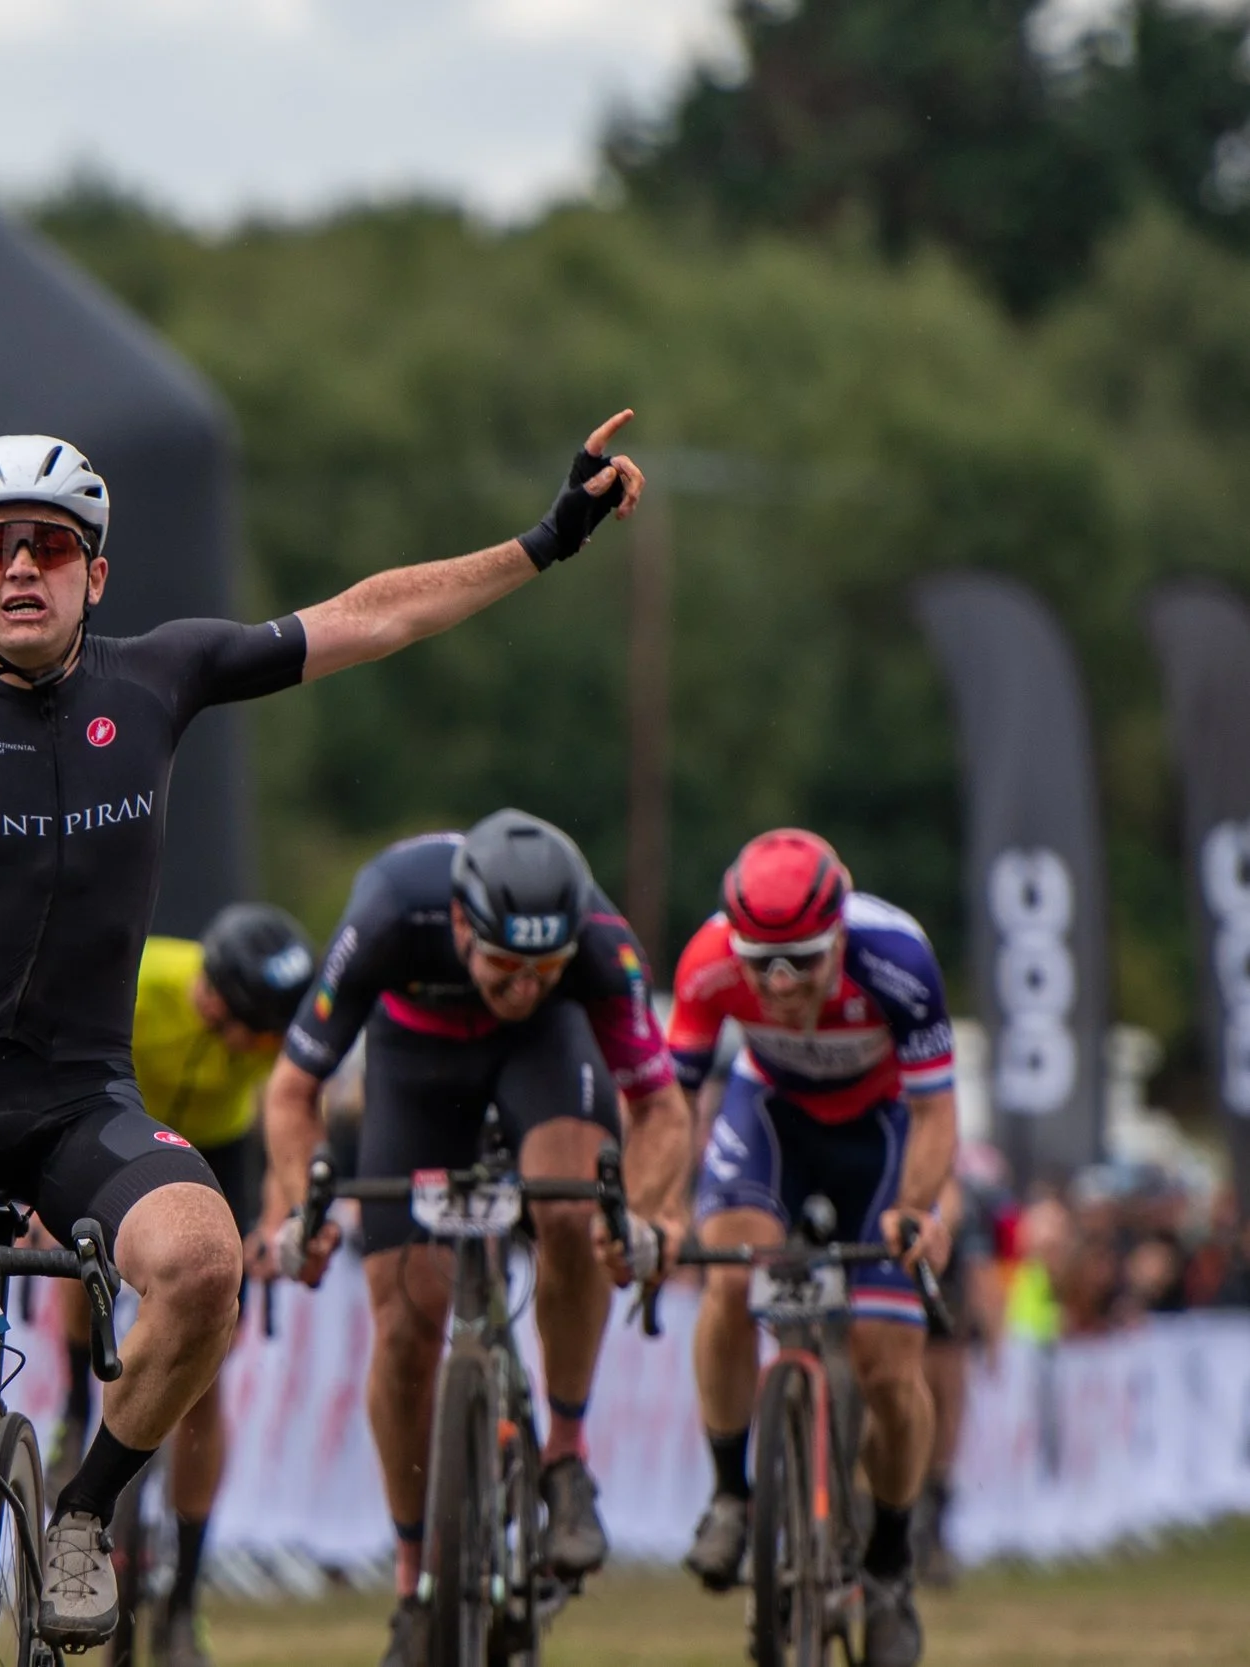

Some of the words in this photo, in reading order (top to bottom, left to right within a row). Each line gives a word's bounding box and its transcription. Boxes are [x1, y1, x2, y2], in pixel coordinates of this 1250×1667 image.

[64, 790, 154, 835] PIRAN
[511, 915, 560, 948] 217
[93, 1283, 108, 1317] GRX
